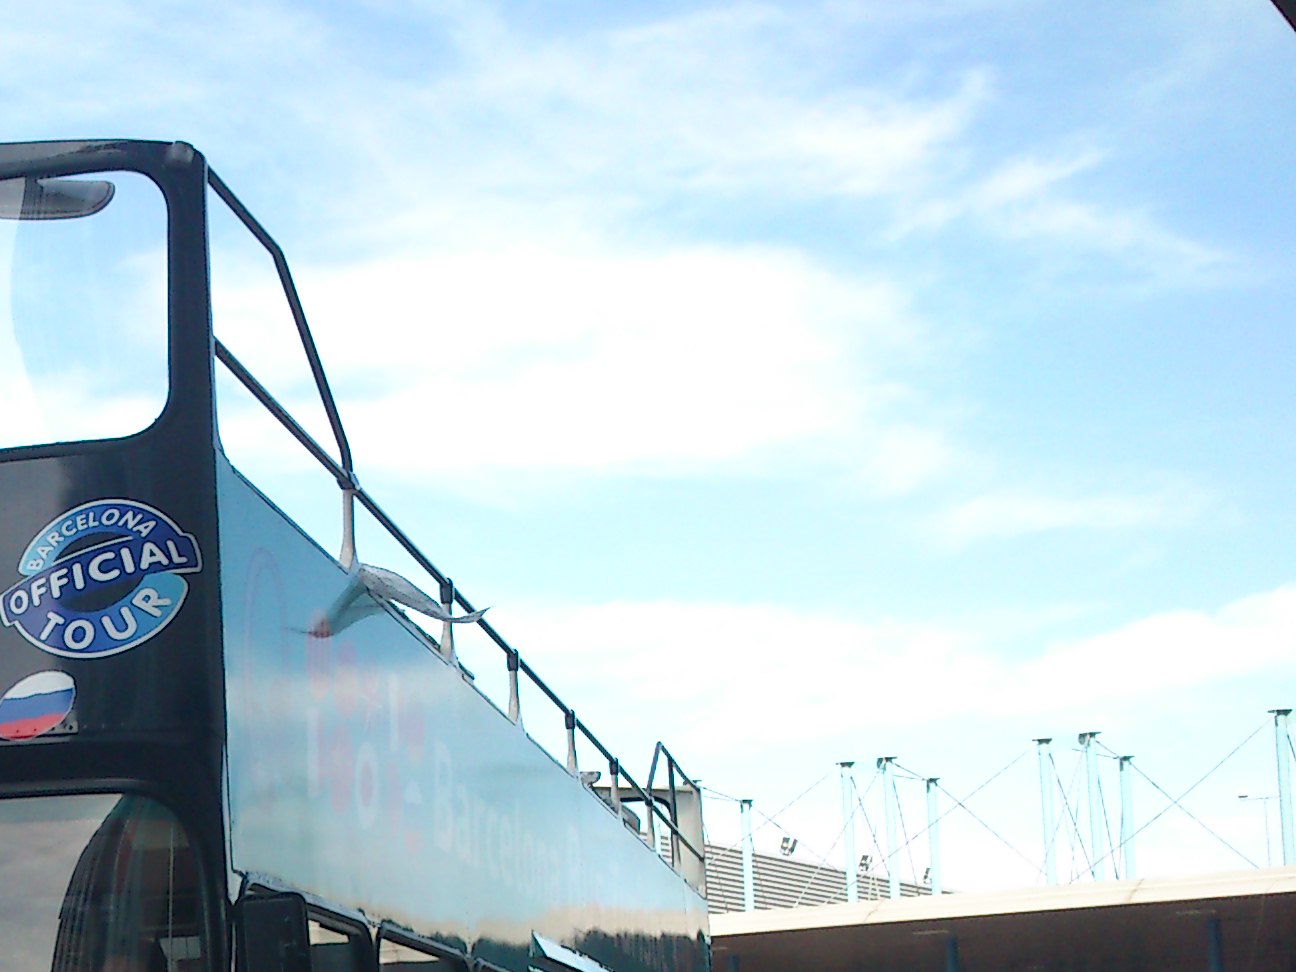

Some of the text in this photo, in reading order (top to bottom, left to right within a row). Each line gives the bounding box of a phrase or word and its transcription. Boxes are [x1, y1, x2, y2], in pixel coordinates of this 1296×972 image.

[26, 507, 157, 573] BARCELONA
[8, 539, 189, 615] OFFICIAL
[38, 586, 174, 651] TOUR
